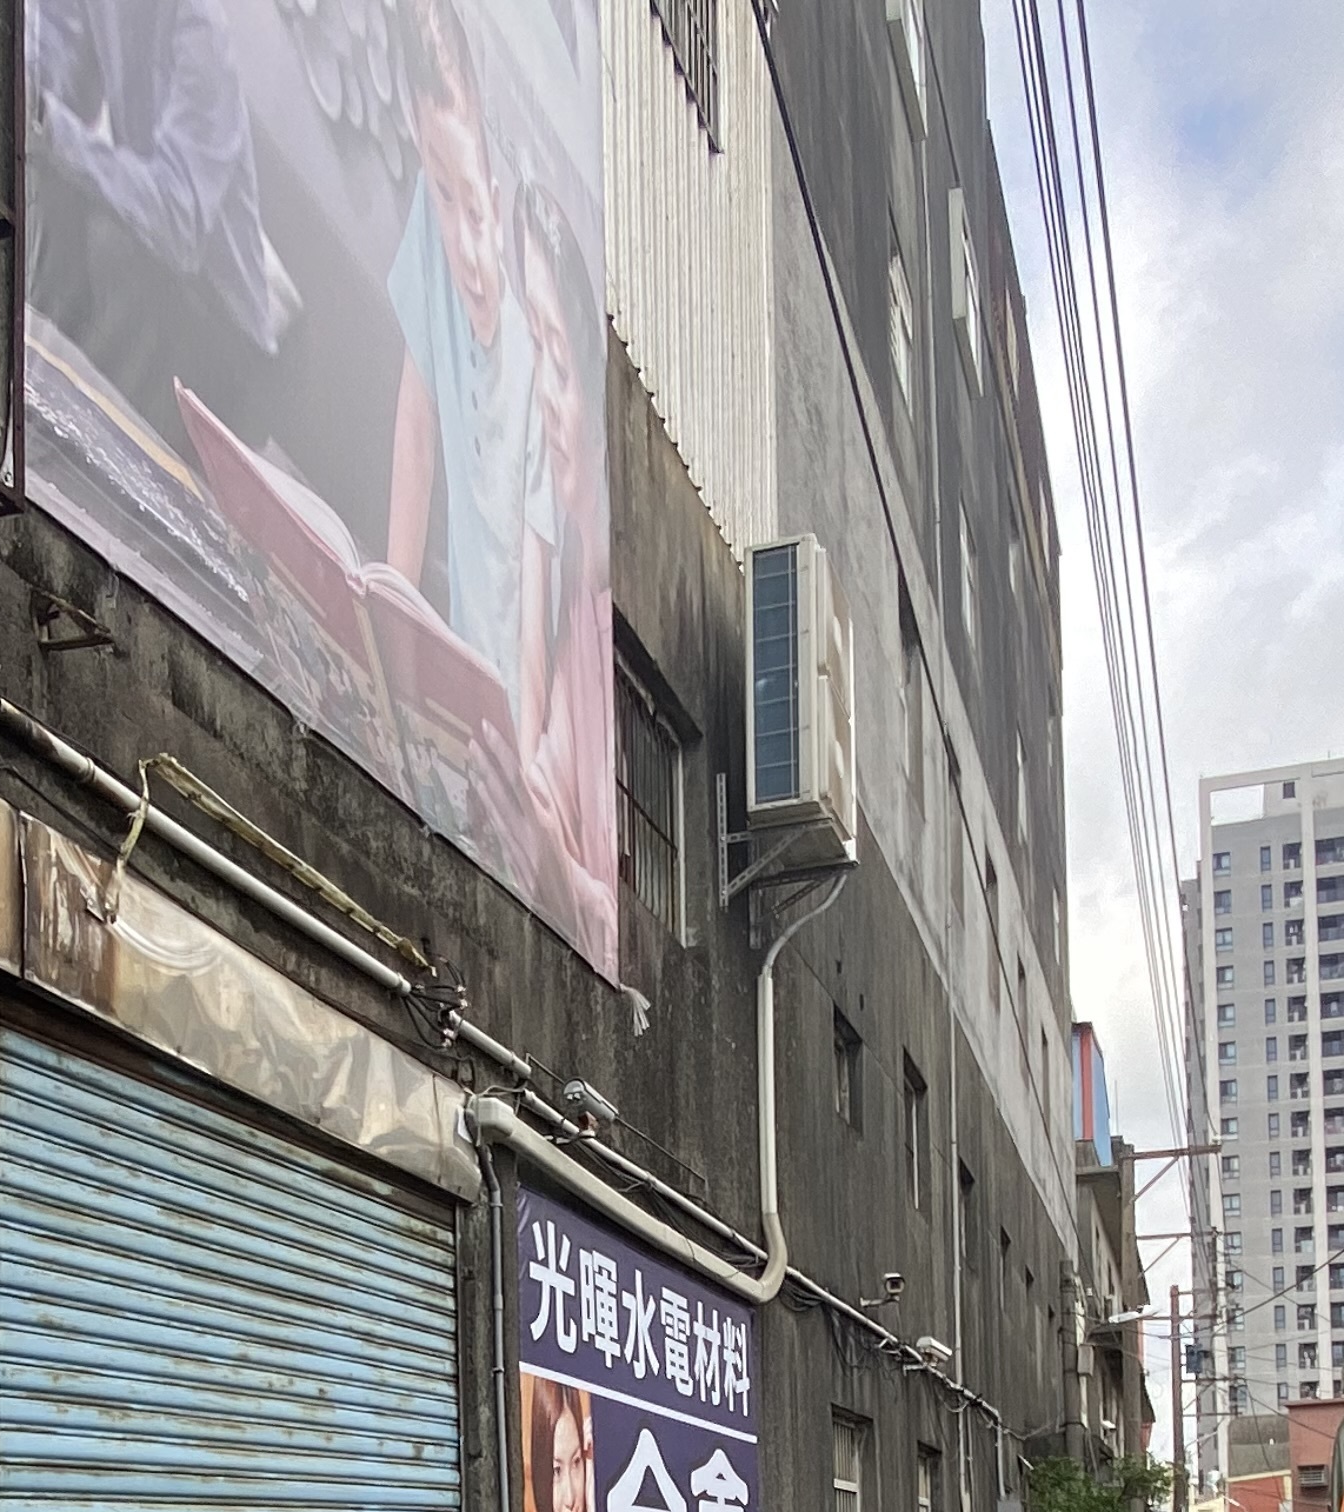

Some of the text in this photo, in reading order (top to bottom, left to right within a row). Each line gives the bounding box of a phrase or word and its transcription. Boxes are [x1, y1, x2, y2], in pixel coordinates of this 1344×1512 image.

[528, 1219, 751, 1417] 光暉水電材料
